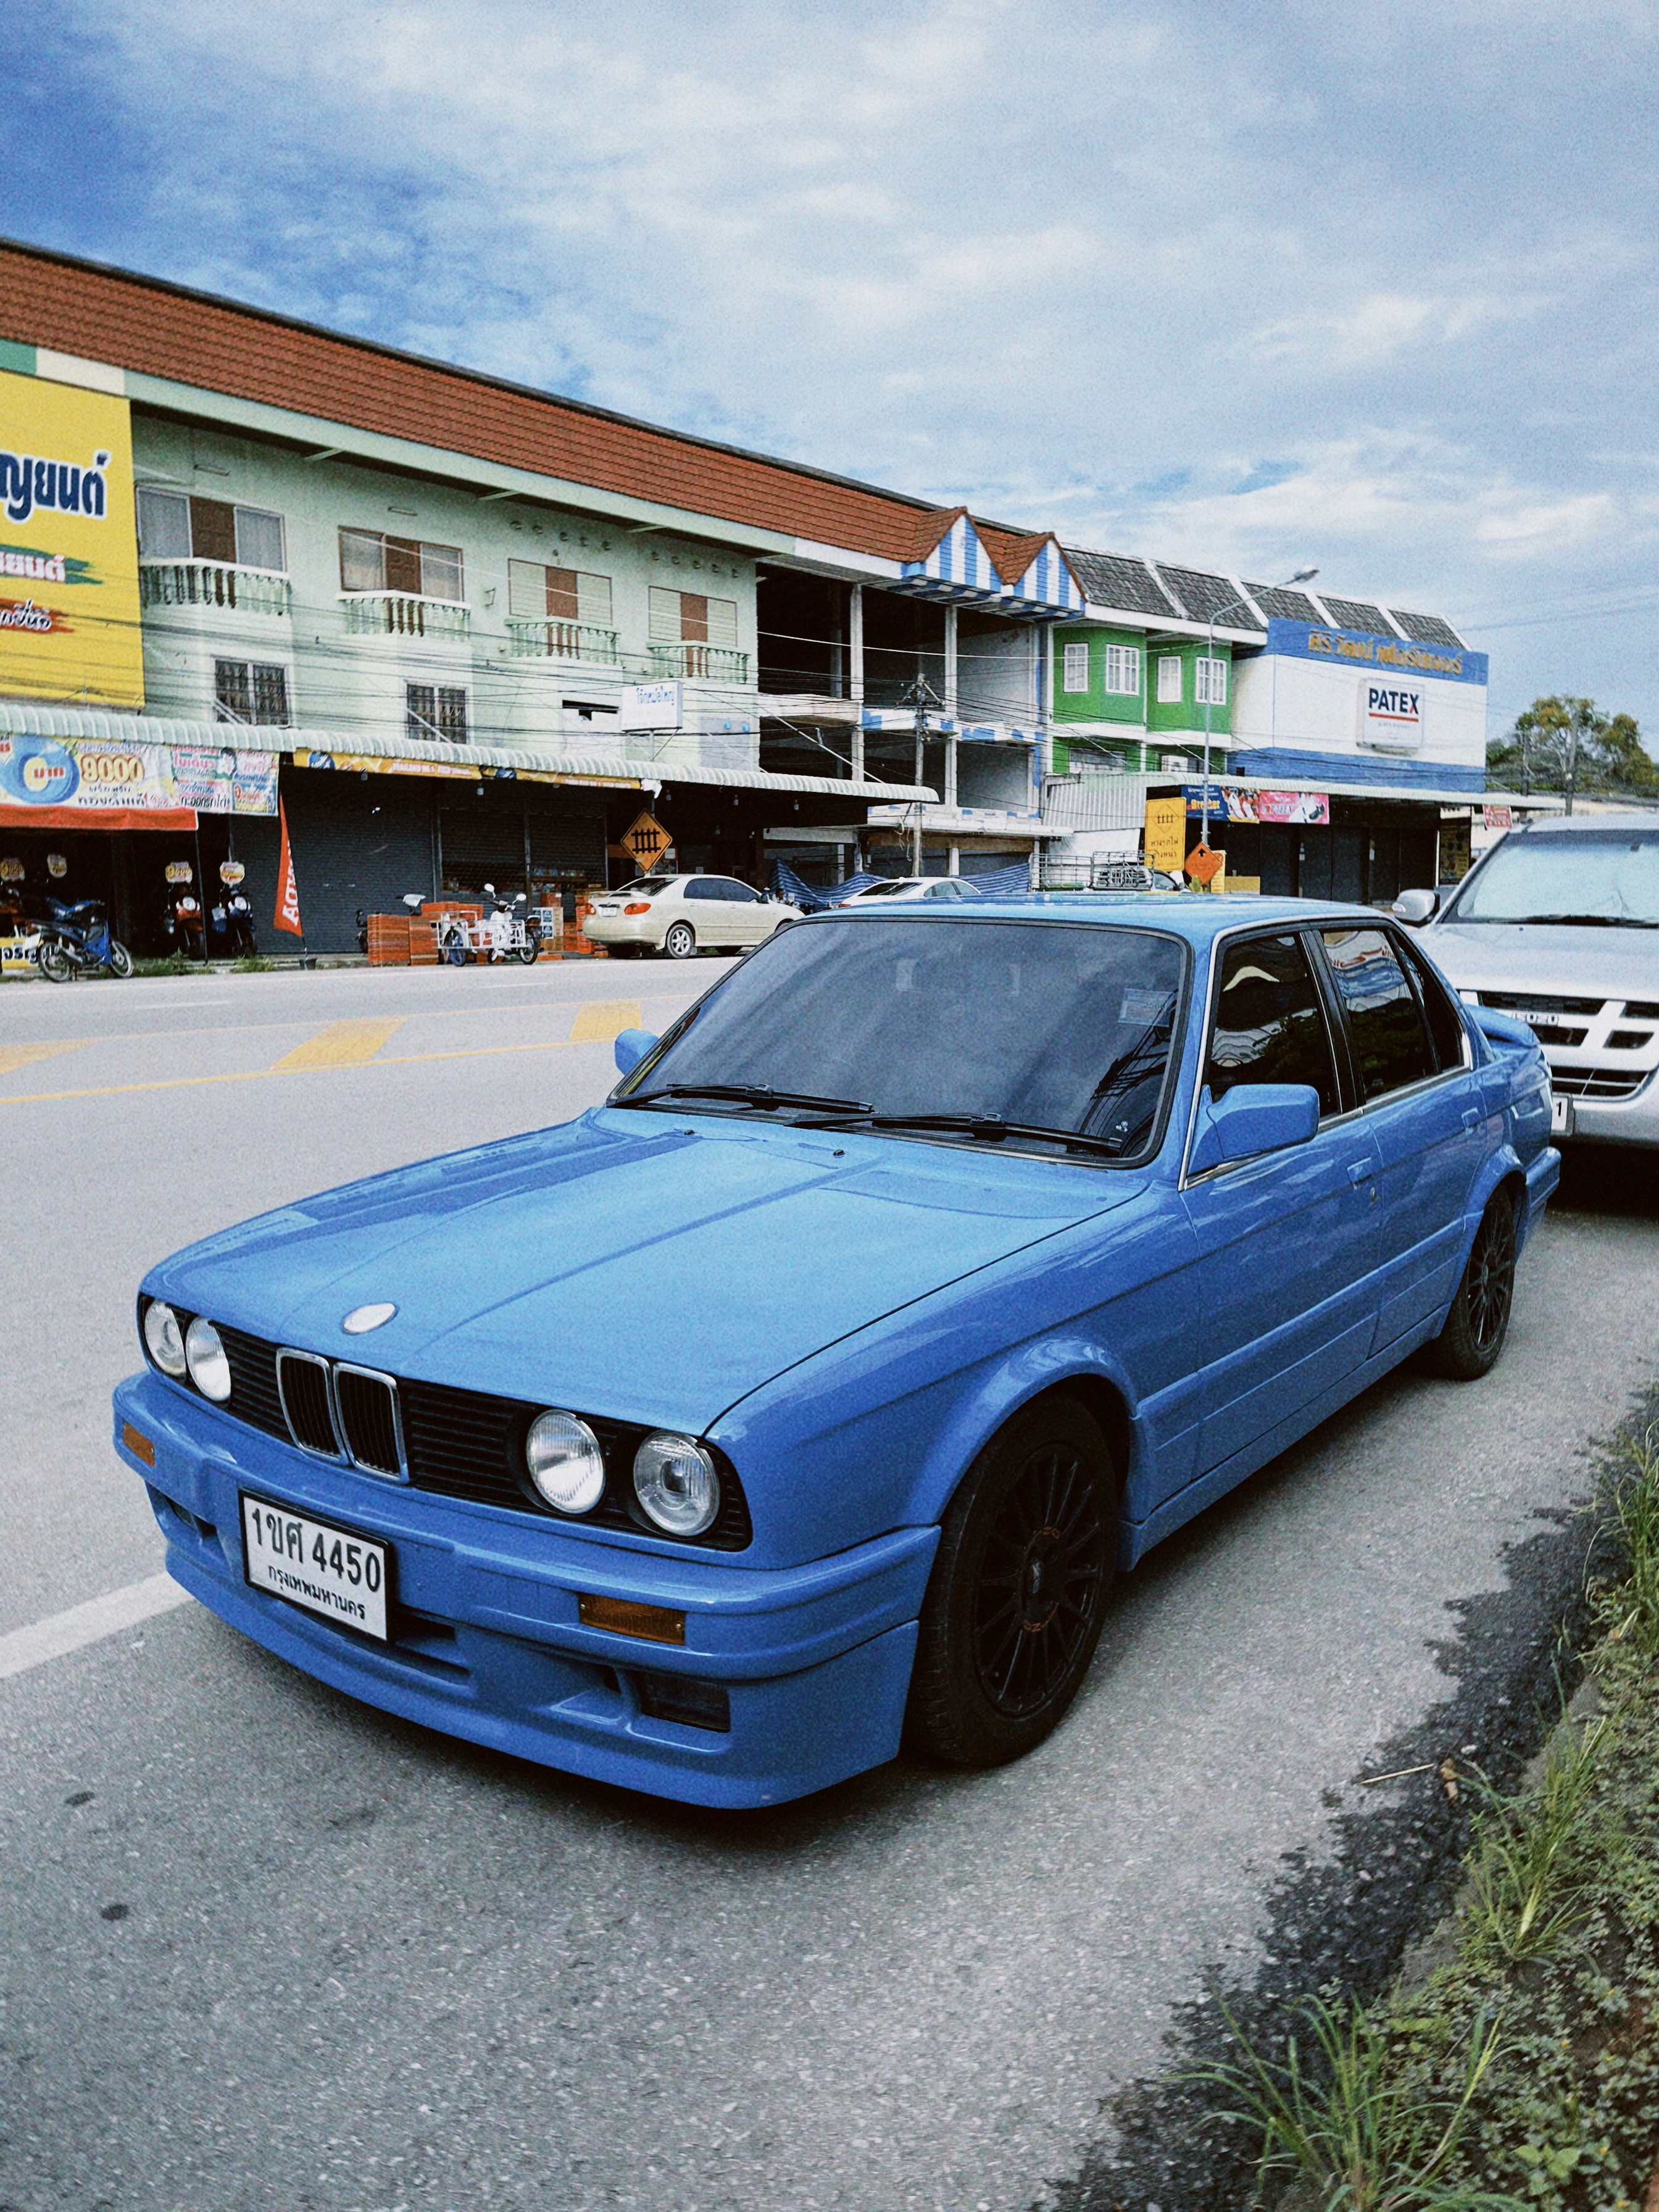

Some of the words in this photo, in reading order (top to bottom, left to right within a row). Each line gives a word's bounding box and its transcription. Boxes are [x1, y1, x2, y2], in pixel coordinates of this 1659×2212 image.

[1368, 687, 1420, 715] PATEX
[1150, 836, 1178, 846] ทางรถไฟ
[1155, 848, 1177, 858] างหน้า
[1511, 1011, 1560, 1026] ISUZU
[252, 1507, 304, 1564] 1ขศ
[312, 1532, 381, 1593] 4450
[268, 1565, 366, 1621] กรุงเทพมหานคร
